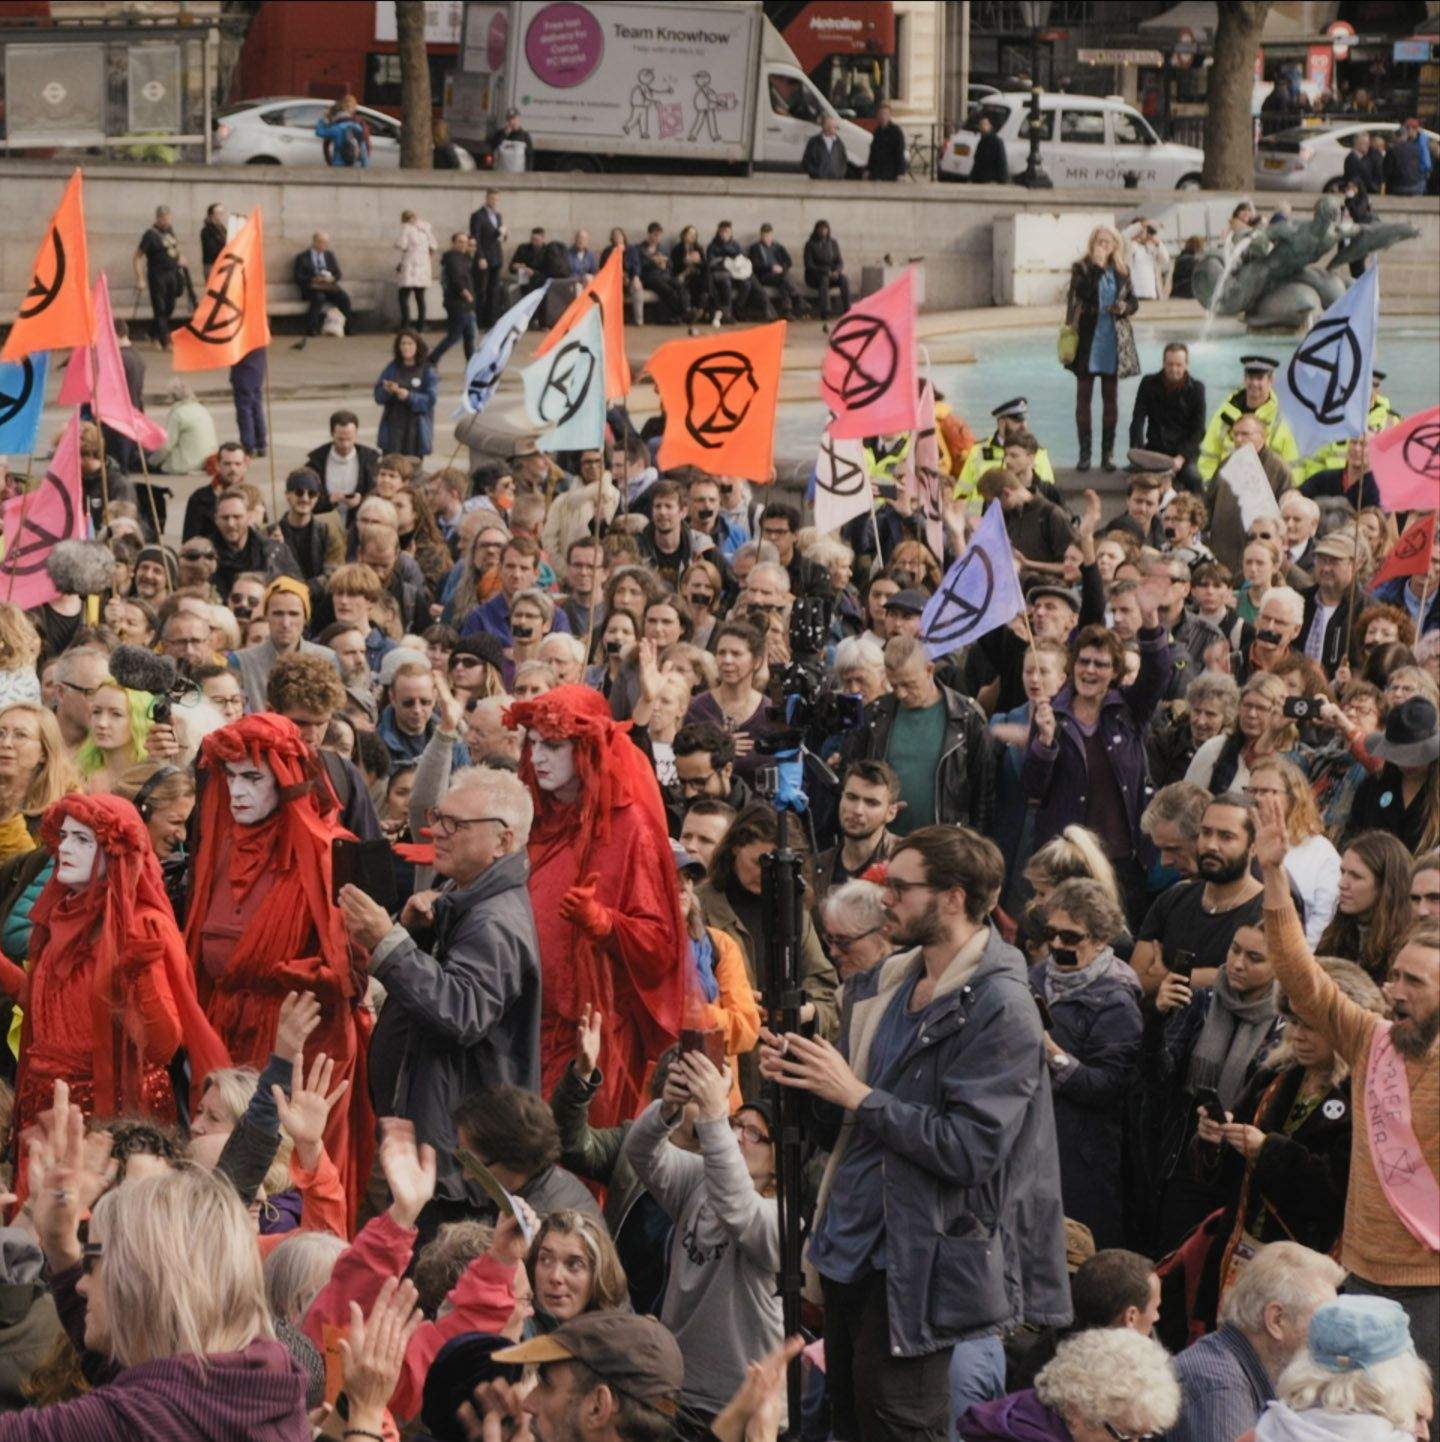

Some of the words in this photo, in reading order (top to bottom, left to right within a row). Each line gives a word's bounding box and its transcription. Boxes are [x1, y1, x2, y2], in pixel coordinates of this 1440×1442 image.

[614, 23, 654, 39] Team
[656, 27, 730, 44] Knowhow
[1065, 167, 1089, 179] MR
[1095, 167, 1157, 181] PORER
